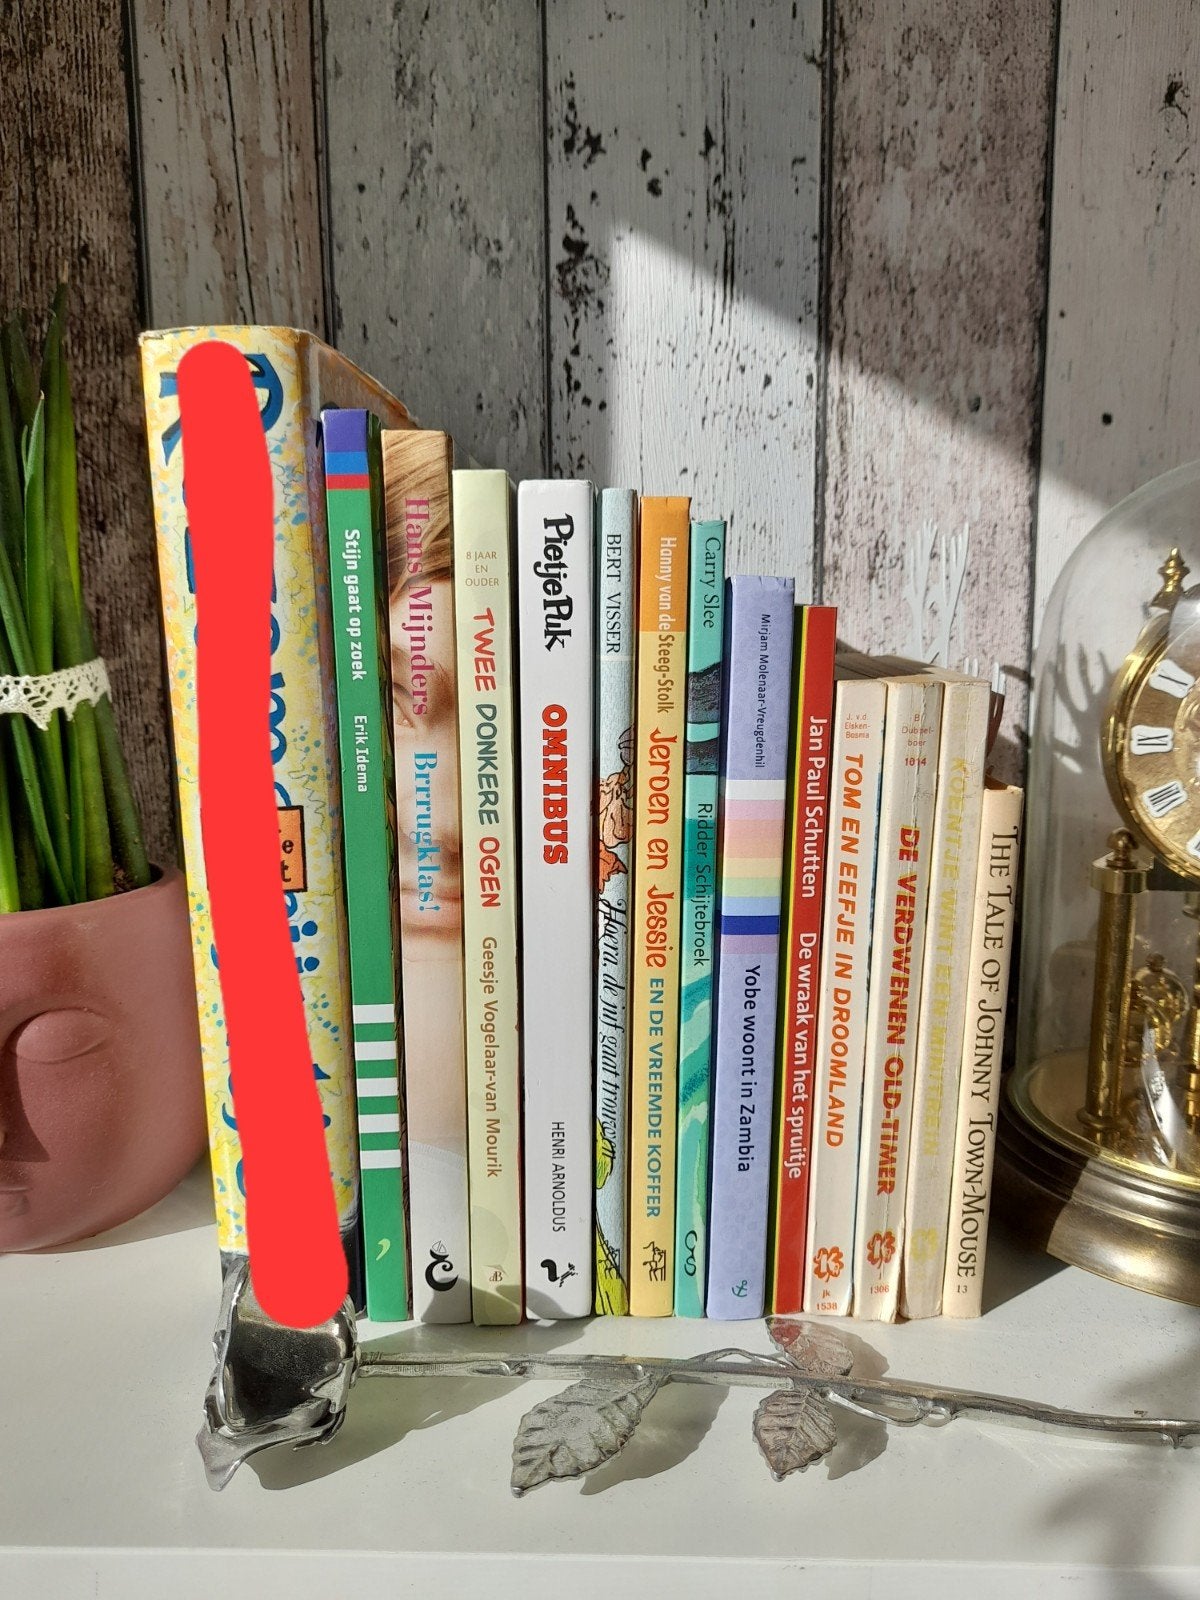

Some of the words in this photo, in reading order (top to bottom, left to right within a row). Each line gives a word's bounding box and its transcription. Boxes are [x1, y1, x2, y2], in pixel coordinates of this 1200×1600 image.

[342, 529, 361, 570] Stijn
[405, 497, 430, 574] Hans
[466, 551, 472, 560] 8
[474, 551, 497, 561] JAAR
[606, 534, 622, 582] BERT
[655, 537, 677, 582] Hanny
[465, 578, 499, 587] OUDER
[475, 564, 488, 573] EN
[700, 537, 722, 589] Carry
[343, 575, 362, 614] gaat
[659, 584, 673, 611] van
[703, 594, 721, 629] Slee
[346, 618, 361, 637] op
[606, 592, 622, 654] VISSER
[658, 613, 676, 630] de
[758, 613, 771, 652] Mirjam
[350, 641, 368, 681] zoek
[402, 585, 435, 716] Mijnders
[473, 607, 497, 692] TWEE
[653, 634, 675, 714] Steeg-Stolk
[354, 715, 369, 745] Erik
[753, 654, 769, 768] Molenaar-Vreugdenhil
[808, 716, 828, 751] Jan
[845, 731, 870, 739] Bosma
[356, 748, 369, 792] Idema
[475, 704, 501, 826] DONKERE
[541, 703, 569, 866] OMNIBUS
[648, 727, 678, 825] Jeroen
[806, 757, 826, 801] Paul
[842, 753, 864, 809] TOM
[905, 757, 927, 767] 1014
[409, 750, 441, 911] Brrrugklas!
[696, 803, 713, 858] Ridder
[841, 817, 861, 855] EN
[943, 756, 968, 880] KOENTJE
[647, 839, 669, 872] en
[801, 805, 824, 898] Schutten
[898, 826, 921, 863] DE
[989, 825, 1019, 878] THE
[479, 836, 501, 908] OGEN
[645, 884, 675, 968] Jessie
[691, 864, 711, 967] Schijtebroek
[836, 861, 858, 945] EEFJE
[937, 888, 957, 957] WINT
[983, 884, 1013, 950] TALE
[479, 937, 499, 995] Geesje
[798, 932, 817, 960] De
[834, 952, 853, 980] IN
[886, 874, 918, 1046] VERDWENEN
[602, 973, 626, 997] de
[649, 978, 664, 1004] EN
[744, 965, 761, 1010] Yobe
[796, 964, 815, 1025] wraak
[933, 963, 952, 1017] EEN
[980, 958, 1002, 994] OF
[600, 995, 625, 1034] juf
[649, 1010, 664, 1036] DE
[480, 1000, 500, 1112] Vogelaar-van
[599, 1031, 620, 1078] gaat
[741, 1014, 756, 1077] woont
[794, 1030, 808, 1065] van
[826, 987, 852, 1148] DROOMLAND
[971, 998, 1002, 1104] JOHNNY
[647, 1042, 663, 1139] VREEMDE
[740, 1081, 757, 1098] in
[792, 1069, 811, 1102] het
[551, 1121, 565, 1159] HENRI
[601, 1081, 621, 1160] trouwen
[737, 1104, 755, 1172] Zambia
[783, 1106, 807, 1179] spruitje
[876, 1055, 904, 1196] OLD-TIMER
[485, 1118, 503, 1178] Mourik
[551, 1162, 566, 1232] ARNOLDUS
[646, 1144, 662, 1218] KOFFER
[956, 1112, 994, 1278] TOWN-MOUSE
[816, 1303, 837, 1311] 1538
[957, 1284, 969, 1294] 13
